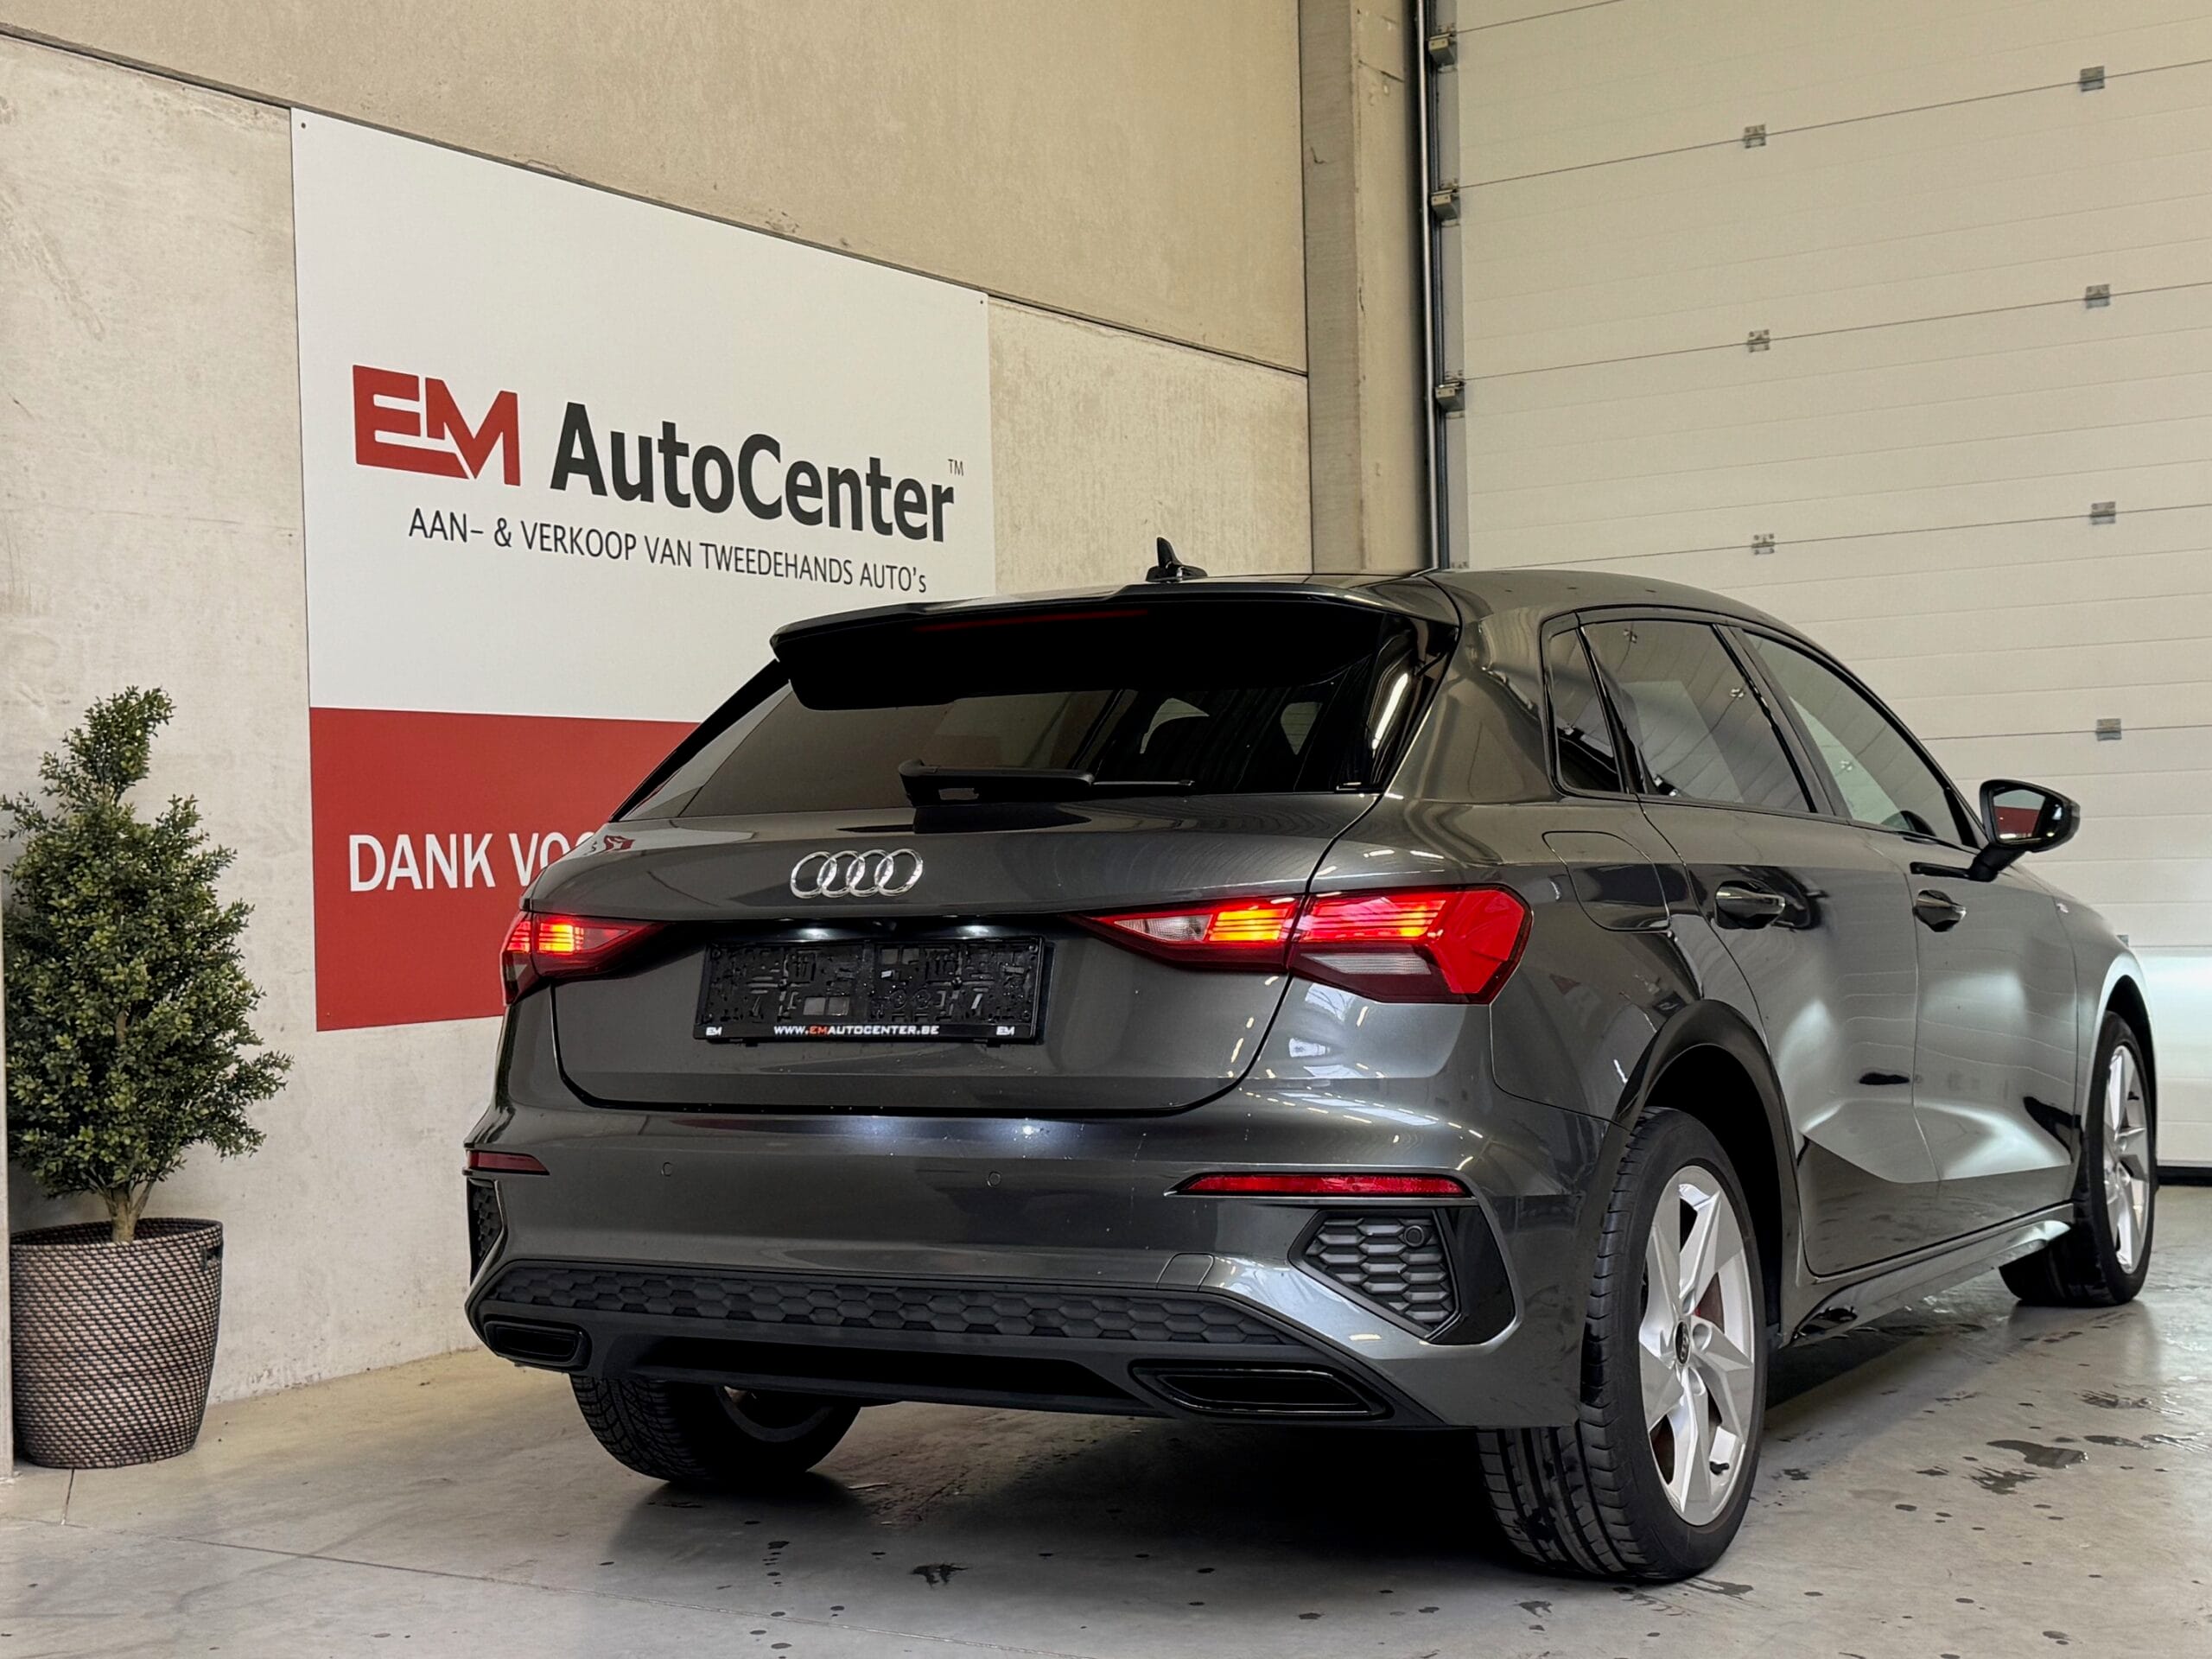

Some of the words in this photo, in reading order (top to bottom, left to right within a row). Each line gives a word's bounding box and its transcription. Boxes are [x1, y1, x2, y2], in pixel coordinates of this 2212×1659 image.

[353, 365, 520, 486] EM
[550, 401, 955, 543] AutoCenter
[409, 507, 484, 543] AAN-
[493, 517, 512, 548] &
[520, 520, 638, 562] VERKOOP
[644, 535, 691, 568] VAN
[699, 542, 853, 586] TWEEDEHANDS
[349, 833, 496, 892] DANK
[508, 831, 596, 887] VO
[705, 1027, 722, 1036] EM
[995, 1026, 1015, 1036] EM
